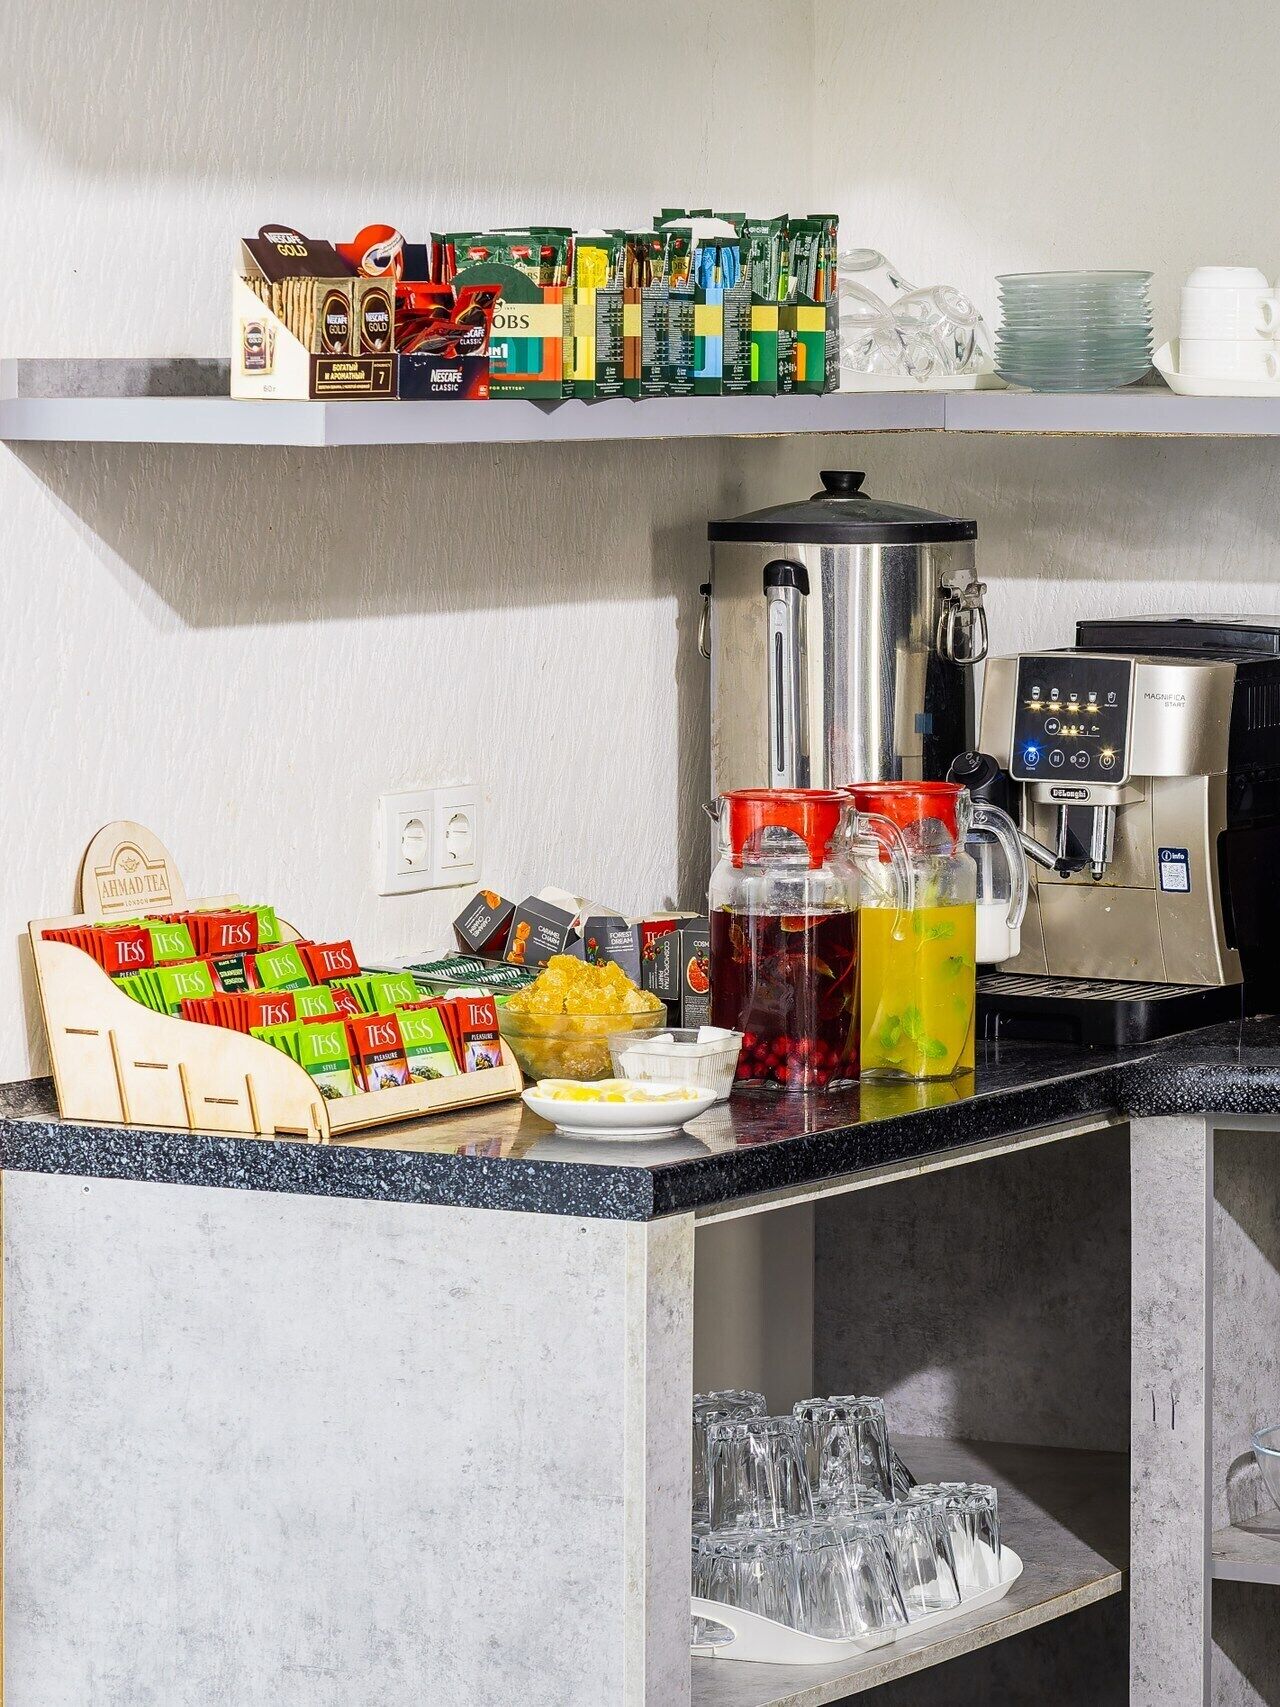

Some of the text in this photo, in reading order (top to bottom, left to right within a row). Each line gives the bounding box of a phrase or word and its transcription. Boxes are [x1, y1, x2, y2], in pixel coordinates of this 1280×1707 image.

[277, 244, 308, 257] GOLD
[329, 325, 347, 334] GOLD
[369, 322, 388, 332] GOLD
[378, 371, 385, 385] 7
[431, 383, 459, 392] CLASSIC
[1143, 692, 1186, 701] MAGNIFICA
[1172, 852, 1185, 860] info
[102, 874, 167, 898] AHMAD TEA
[125, 898, 150, 907] LONDON
[220, 922, 251, 947] TESS
[538, 925, 560, 940] CARAMEL
[609, 931, 632, 939] FOREST
[152, 932, 185, 954] TESS
[541, 934, 560, 946] CHARM
[611, 937, 633, 945] DREAM
[115, 939, 146, 964] TESS
[267, 954, 297, 979] TESS
[320, 948, 353, 972] TESS
[171, 971, 206, 995] TESS
[286, 982, 299, 991] STYLE
[382, 981, 412, 1004] TESS
[299, 995, 328, 1018] TESS
[259, 1002, 290, 1027] TESS
[467, 1003, 494, 1026] TESS
[365, 1022, 397, 1048] TESS
[400, 1017, 434, 1041] TESS
[310, 1032, 341, 1057] TESS
[416, 1047, 433, 1055] STYLE
[374, 1051, 398, 1062] PLEASURE
[322, 1063, 337, 1072] STYLE
